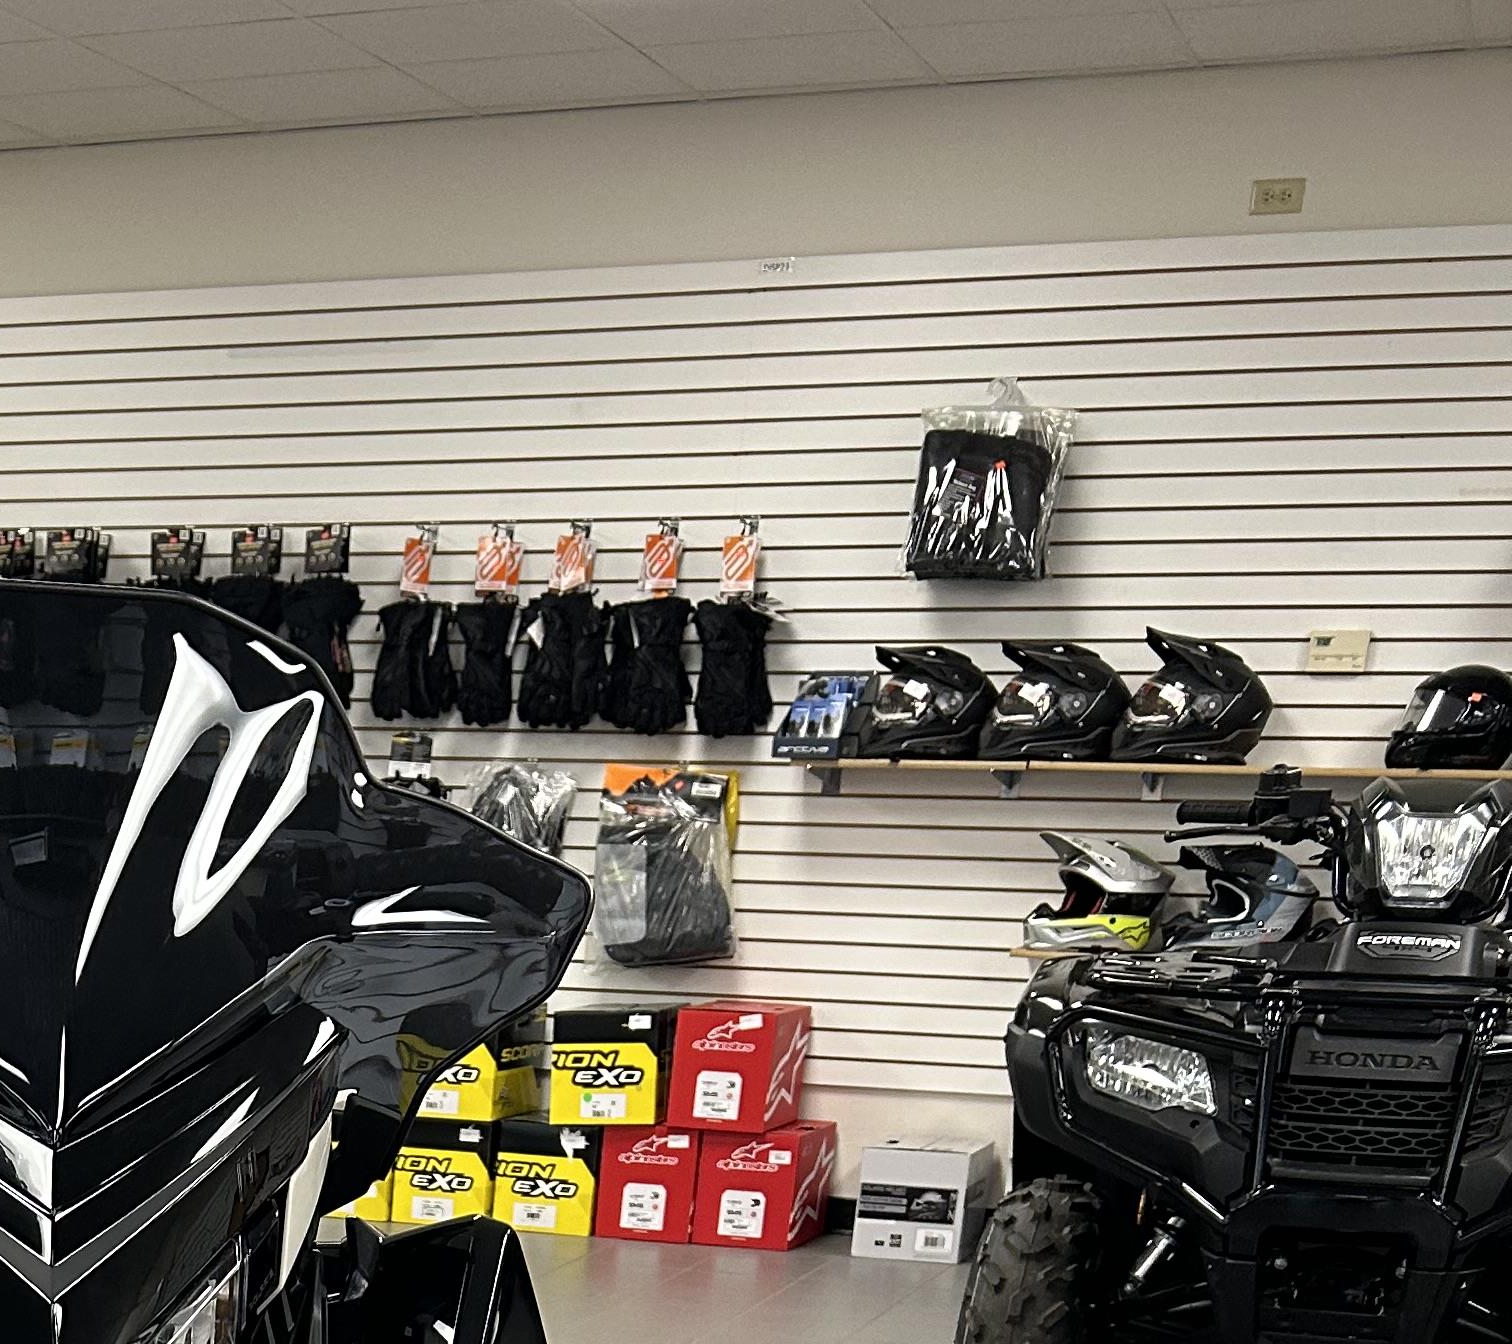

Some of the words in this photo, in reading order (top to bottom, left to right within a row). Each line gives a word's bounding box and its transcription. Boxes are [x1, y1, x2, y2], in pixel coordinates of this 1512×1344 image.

[1356, 934, 1461, 950] FOREMAN
[1305, 1050, 1441, 1071] HONDA
[428, 1065, 479, 1083] XO
[395, 1154, 452, 1173] ION
[496, 1159, 556, 1179] ION
